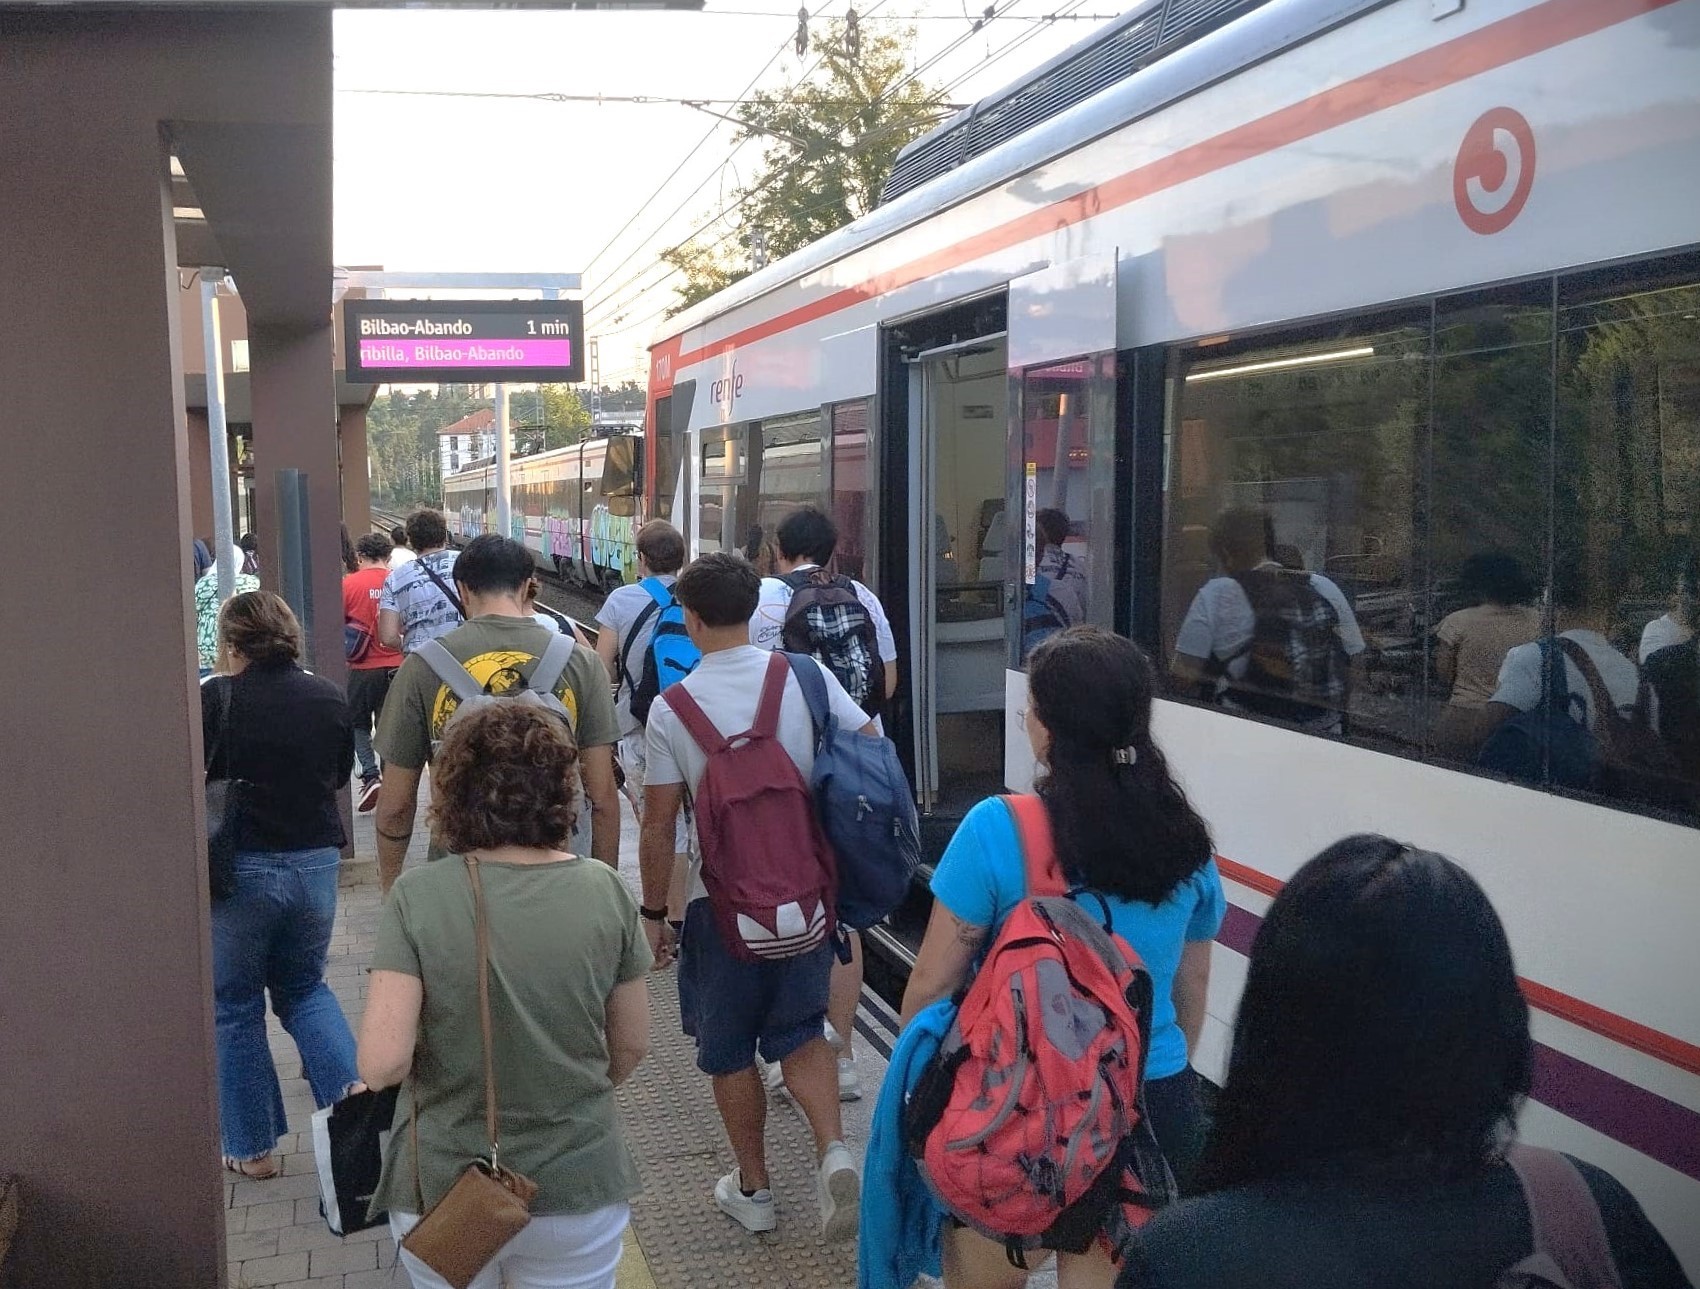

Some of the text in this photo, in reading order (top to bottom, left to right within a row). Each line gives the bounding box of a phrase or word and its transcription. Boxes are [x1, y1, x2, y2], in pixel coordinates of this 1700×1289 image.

[360, 319, 569, 335] Bilbao-Abando 1 min
[415, 345, 524, 361] Bilbao-Abando
[710, 358, 743, 416] renfe
